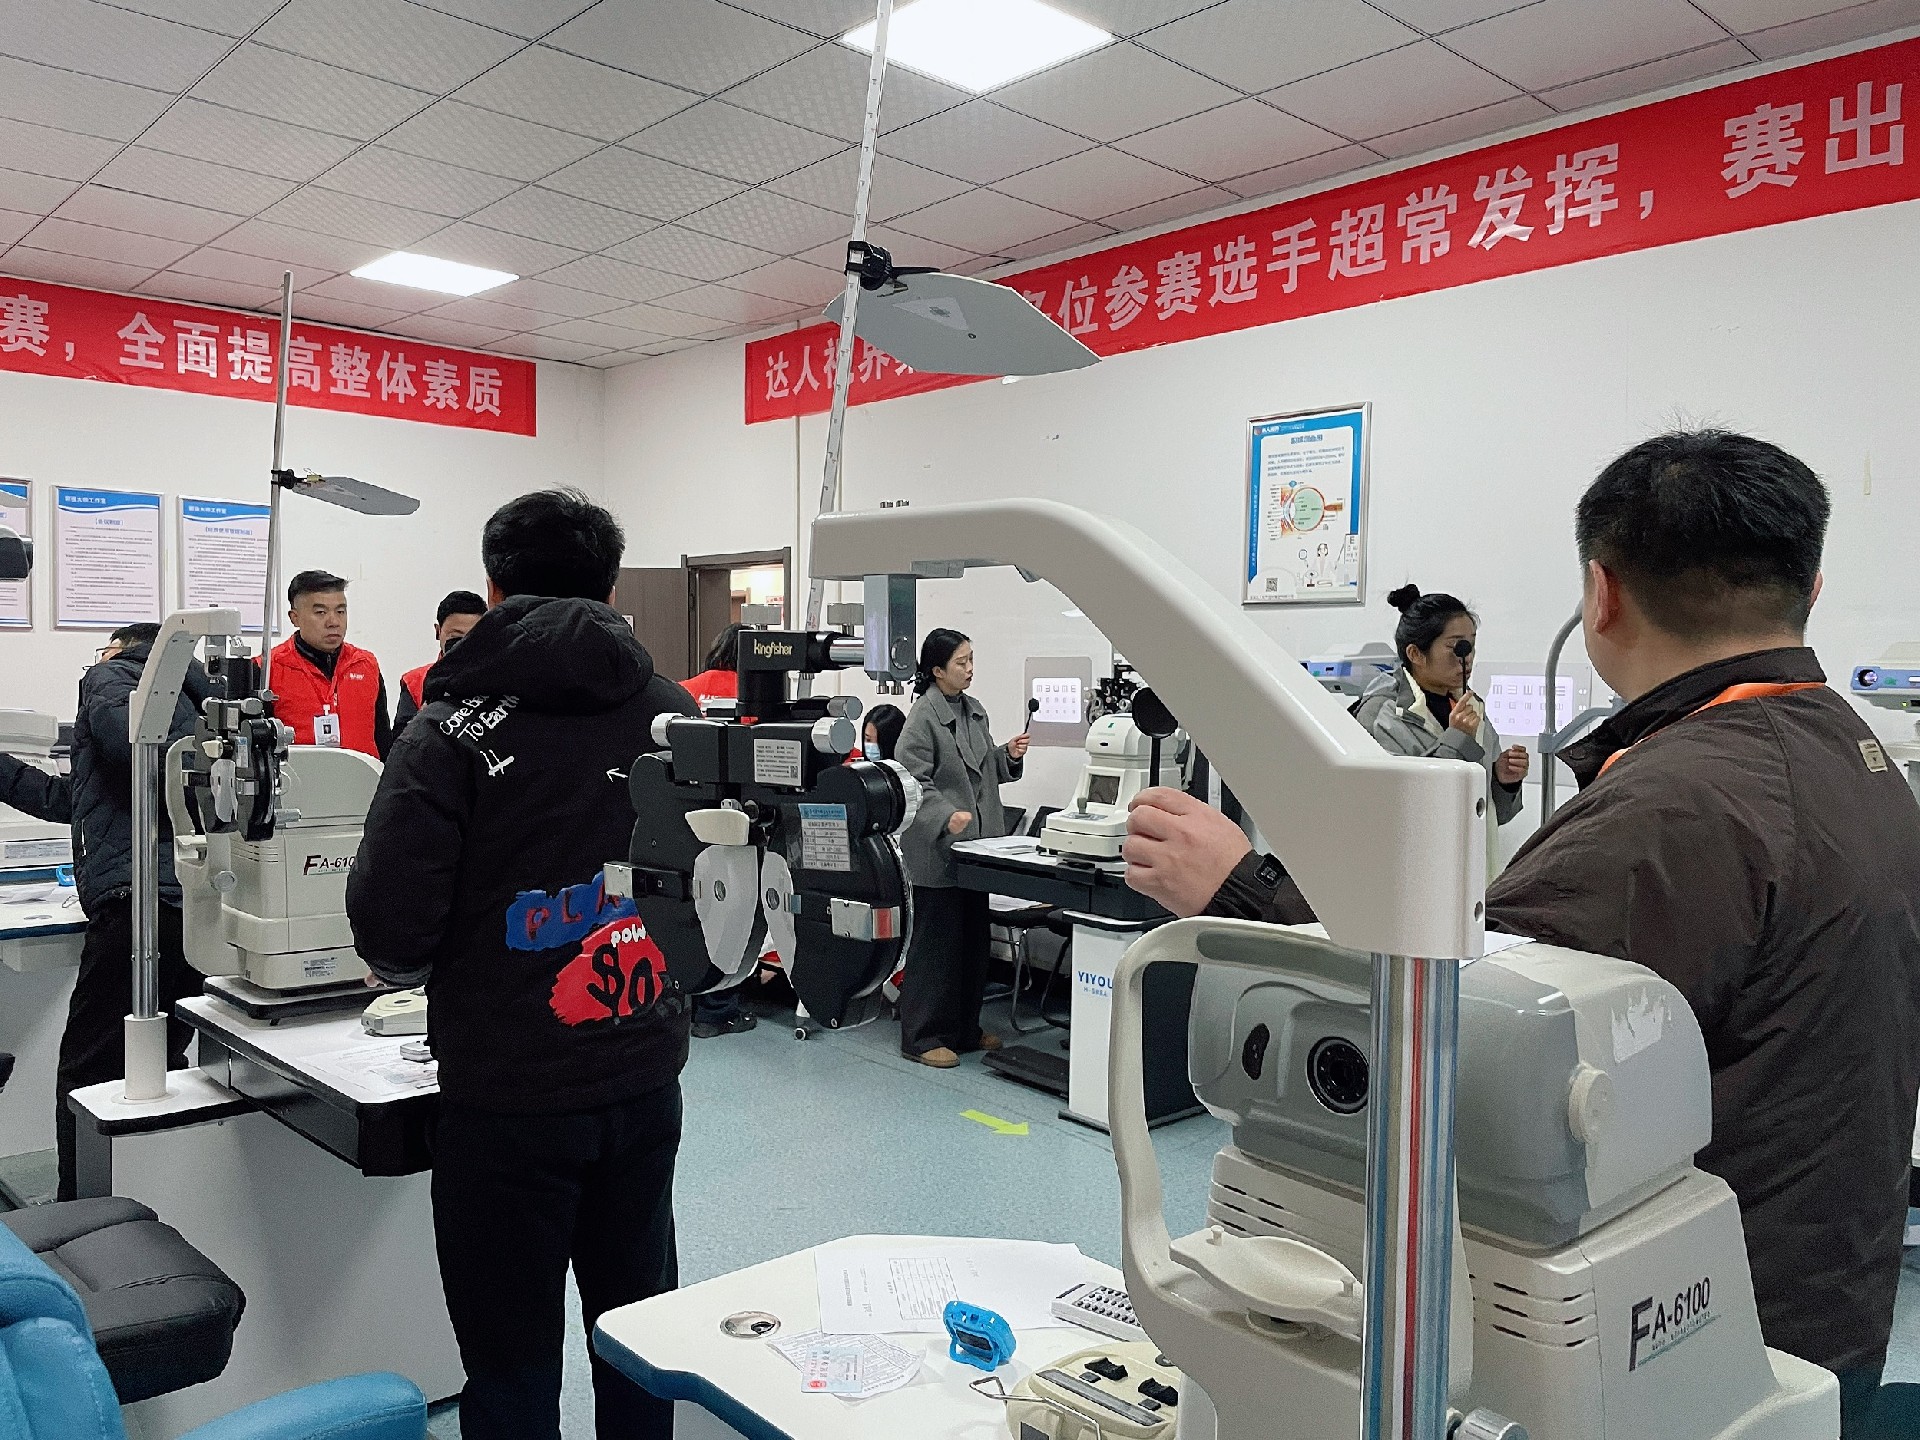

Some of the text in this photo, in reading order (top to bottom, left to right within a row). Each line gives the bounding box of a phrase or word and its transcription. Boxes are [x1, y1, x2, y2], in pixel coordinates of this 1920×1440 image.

[765, 338, 914, 401] 达人视界
[754, 638, 793, 658] kingfisher
[1629, 1276, 1711, 1372] FA-6100
